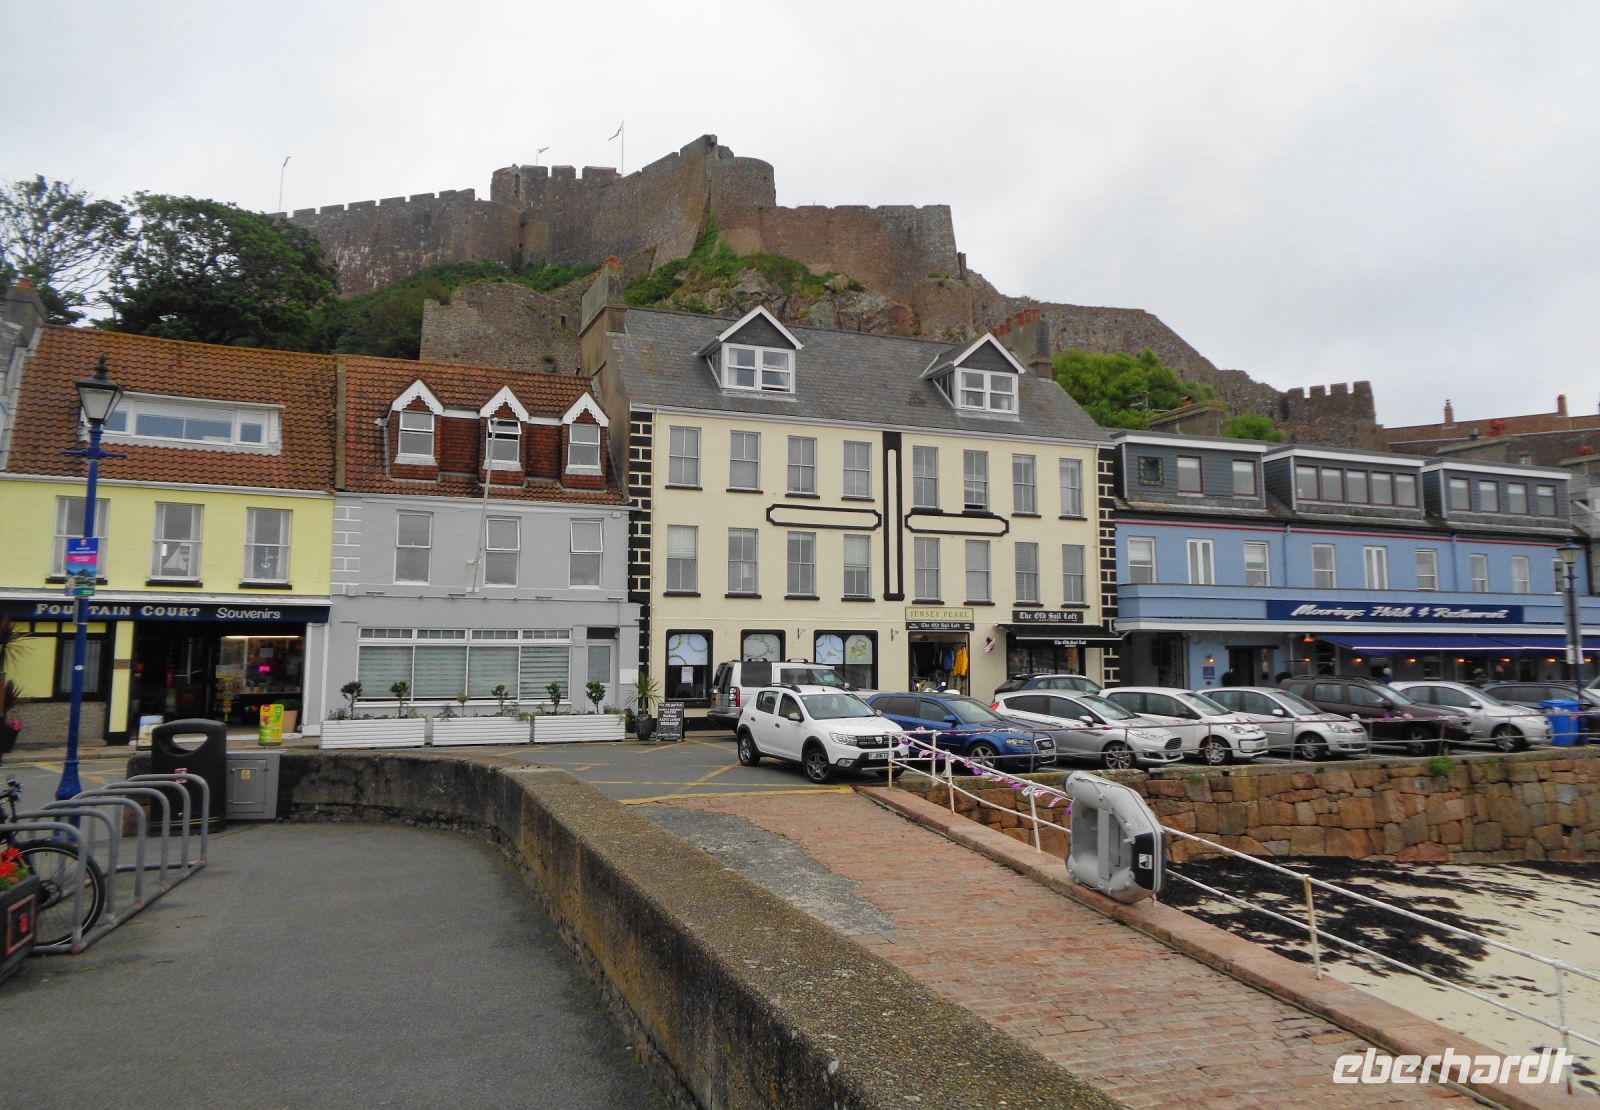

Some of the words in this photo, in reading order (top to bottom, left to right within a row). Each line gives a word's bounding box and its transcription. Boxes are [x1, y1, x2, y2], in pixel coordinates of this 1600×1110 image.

[35, 603, 131, 615] FOUTAIN
[141, 605, 200, 617] COURT
[215, 607, 281, 619] Souvenirs
[910, 610, 940, 618] JERSEY
[943, 611, 969, 619] PEARL
[1019, 611, 1032, 620] The
[1033, 611, 1047, 620] Old
[1048, 612, 1062, 620] Sail
[1063, 612, 1077, 620] Loft
[1290, 604, 1366, 620] Moorings
[1369, 606, 1415, 618] Hotel
